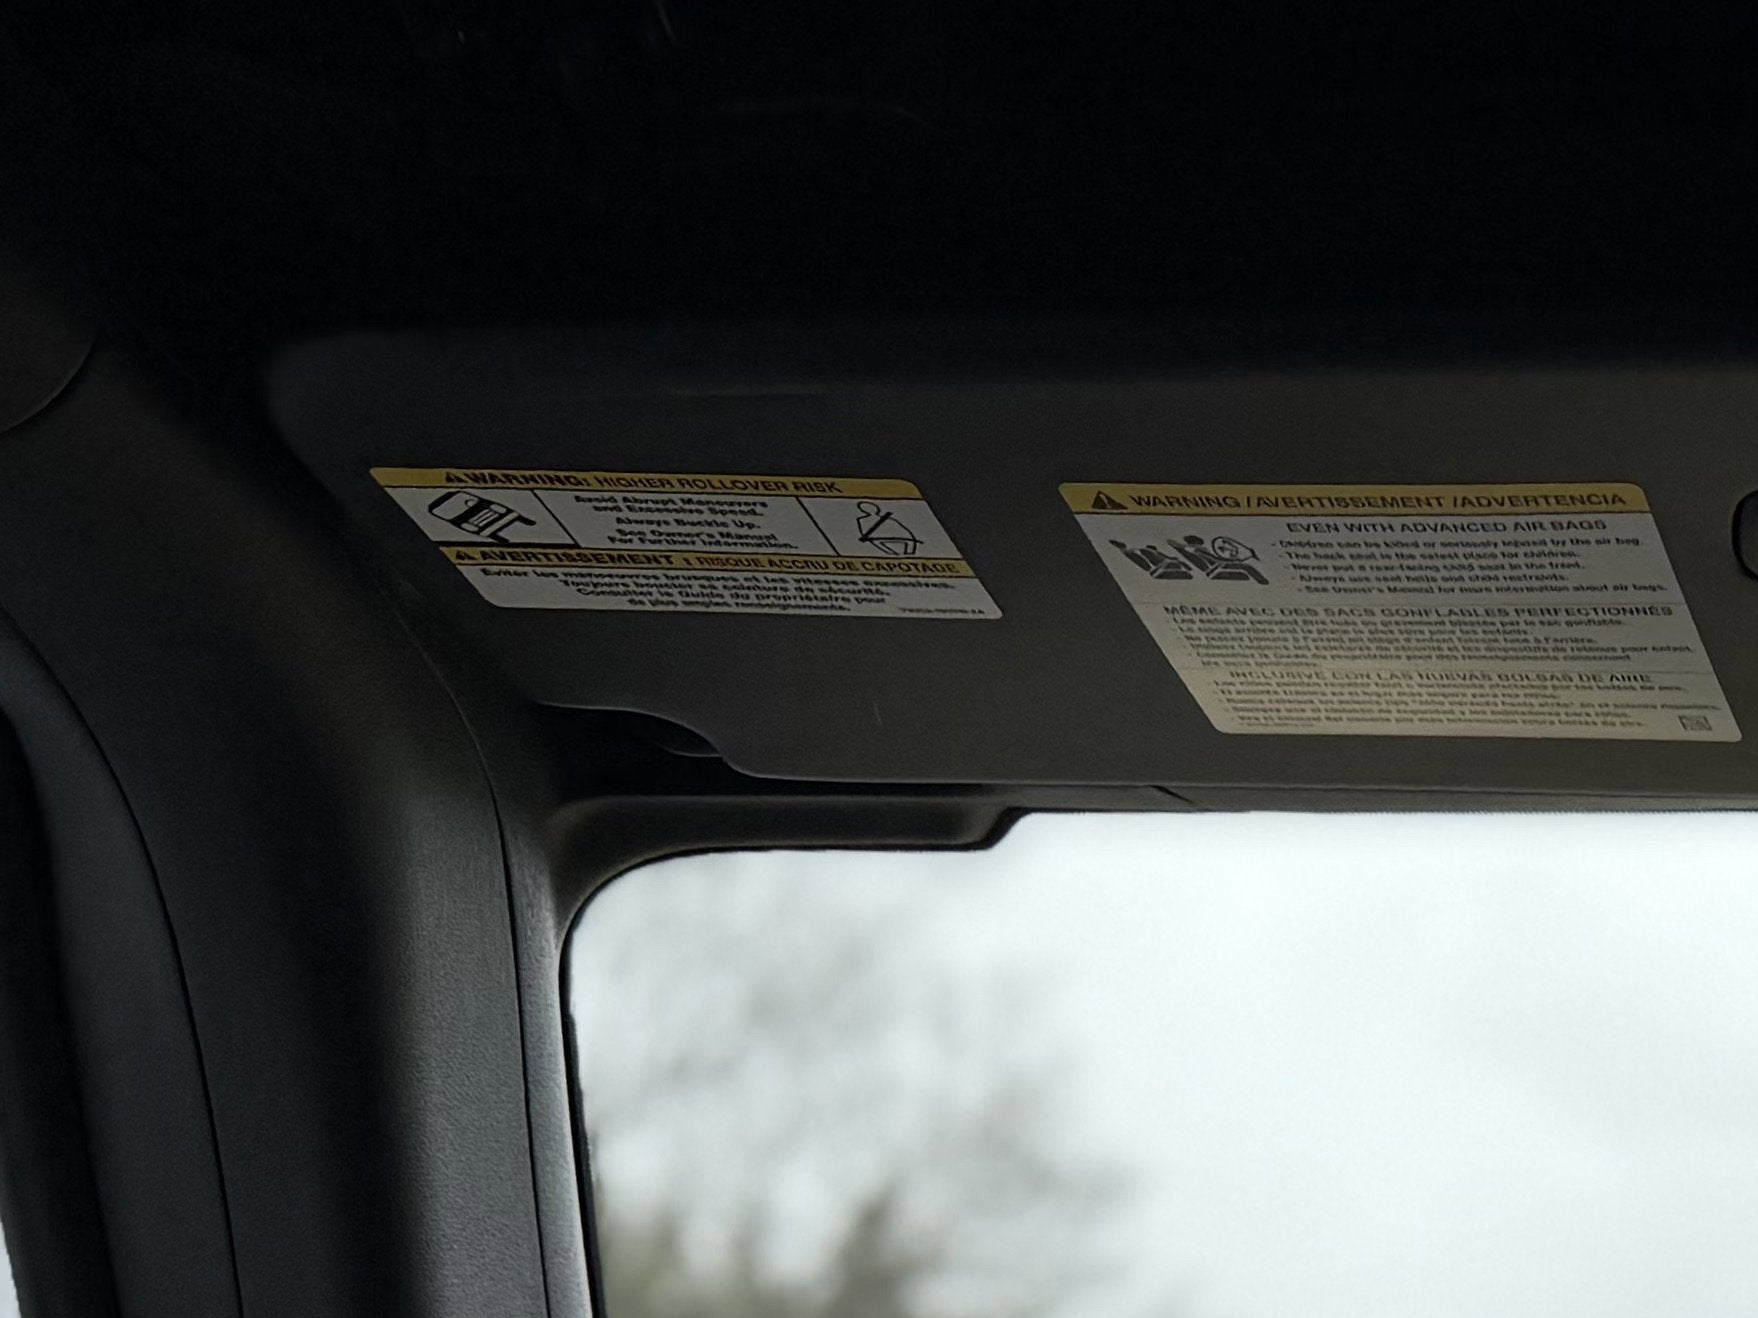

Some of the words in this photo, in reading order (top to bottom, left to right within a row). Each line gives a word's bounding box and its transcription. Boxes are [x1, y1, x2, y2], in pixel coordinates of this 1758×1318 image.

[461, 472, 593, 486] WARNING:
[673, 477, 791, 491] ROLLOVER
[788, 480, 843, 493] RISK
[1128, 495, 1242, 507] WARNING
[1447, 493, 1627, 507] /ADVERTENCIA
[1283, 522, 1341, 533] EVEN
[1342, 522, 1396, 532] WITH
[1396, 522, 1509, 533] ADVANCED
[1509, 520, 1547, 531] AIR
[1547, 519, 1608, 530] BAGS
[473, 549, 682, 568] AVERTISSEMENT
